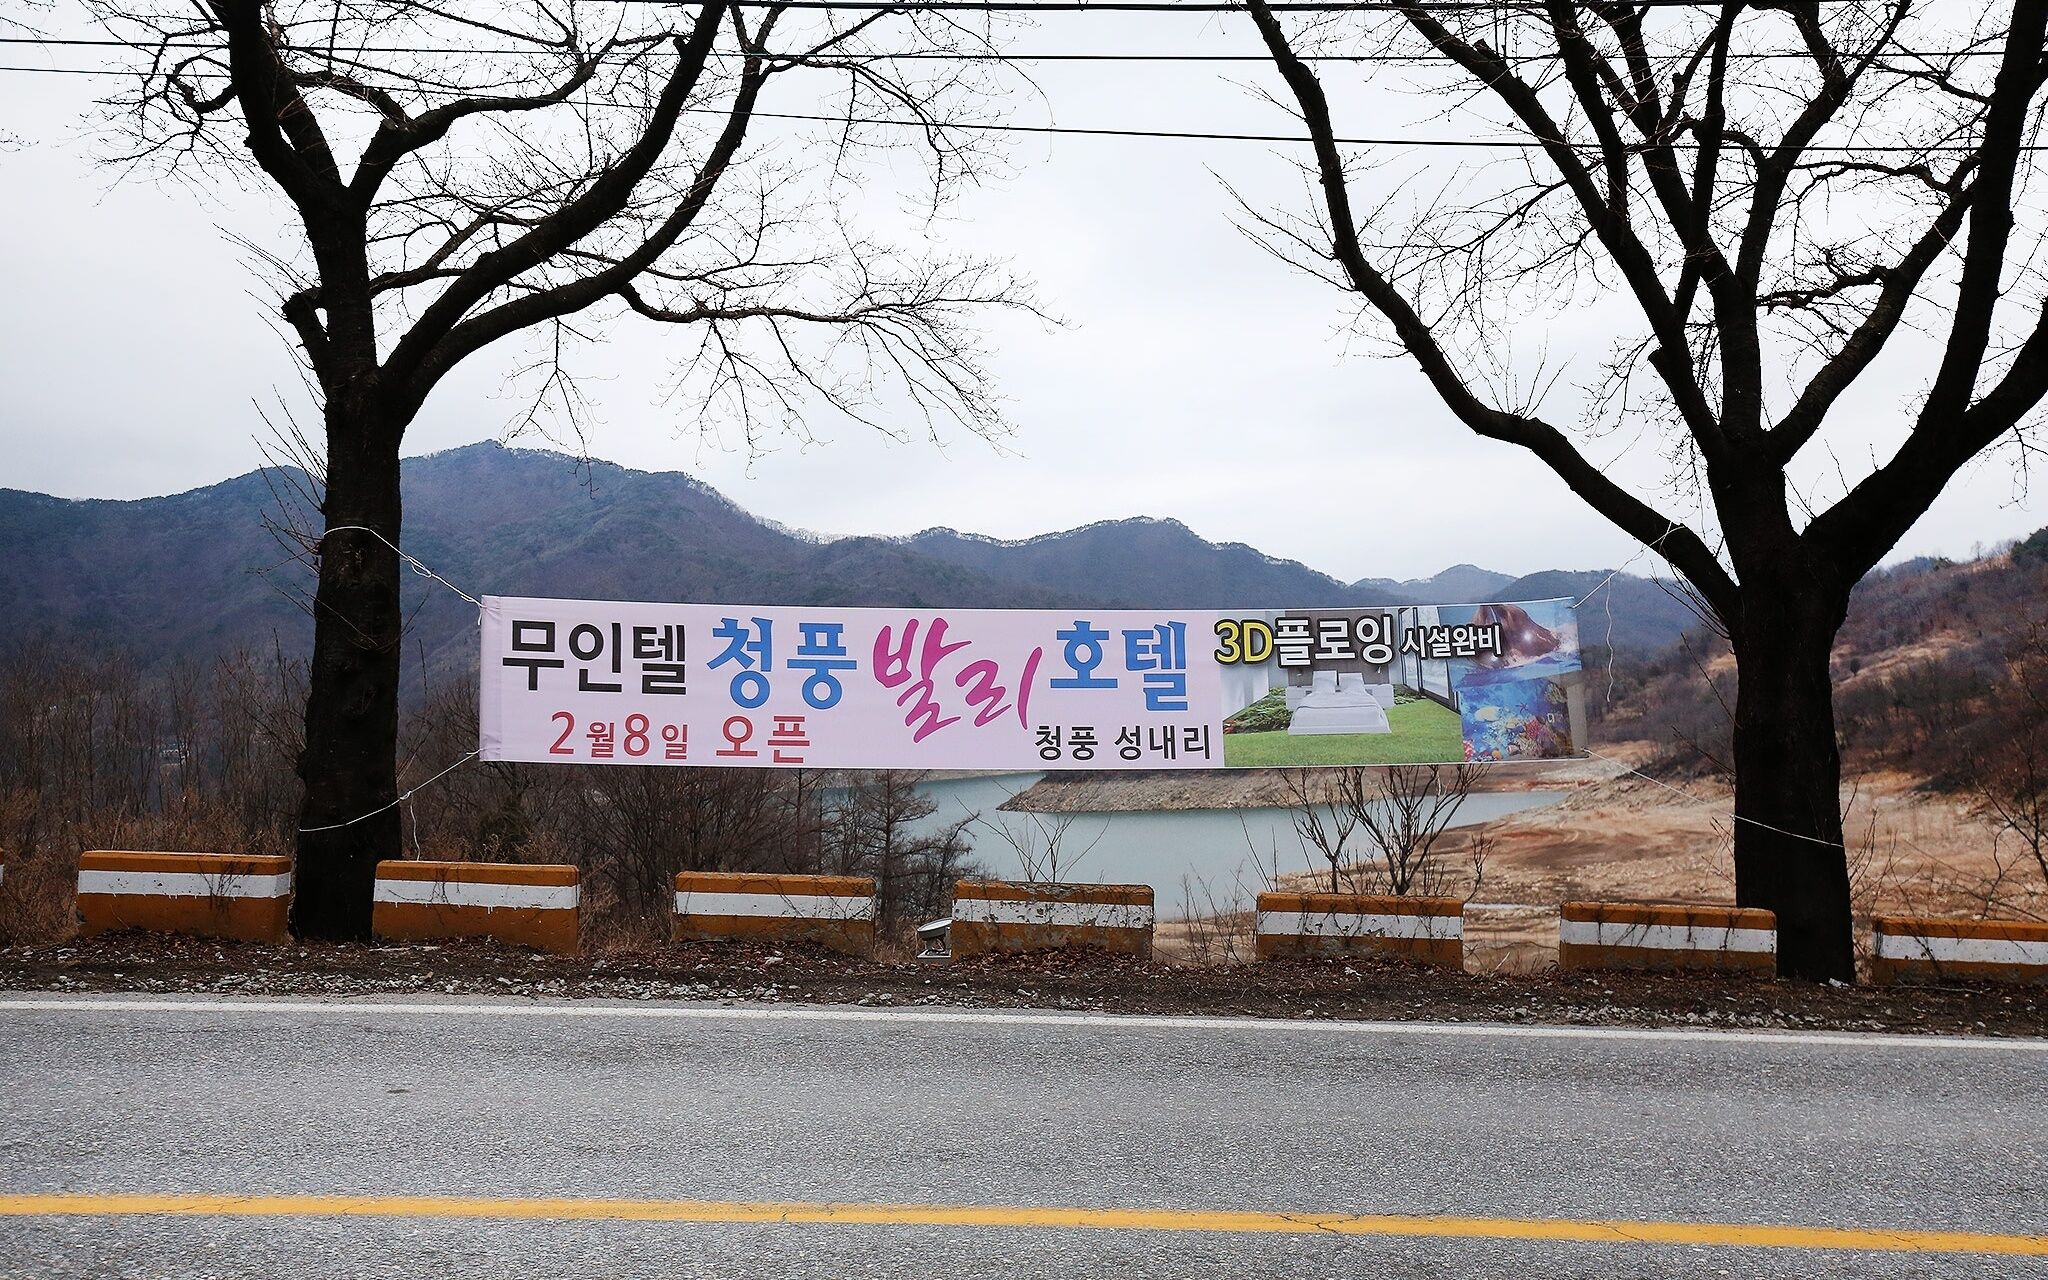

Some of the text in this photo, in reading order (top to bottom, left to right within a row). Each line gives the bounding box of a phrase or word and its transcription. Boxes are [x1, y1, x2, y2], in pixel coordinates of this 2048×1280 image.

[1401, 624, 1503, 659] 시설완비
[502, 616, 1189, 743] 무인텔 청풍 발리 호텔
[716, 715, 811, 764] 오픈
[1034, 724, 1211, 761] 청풍 성내리
